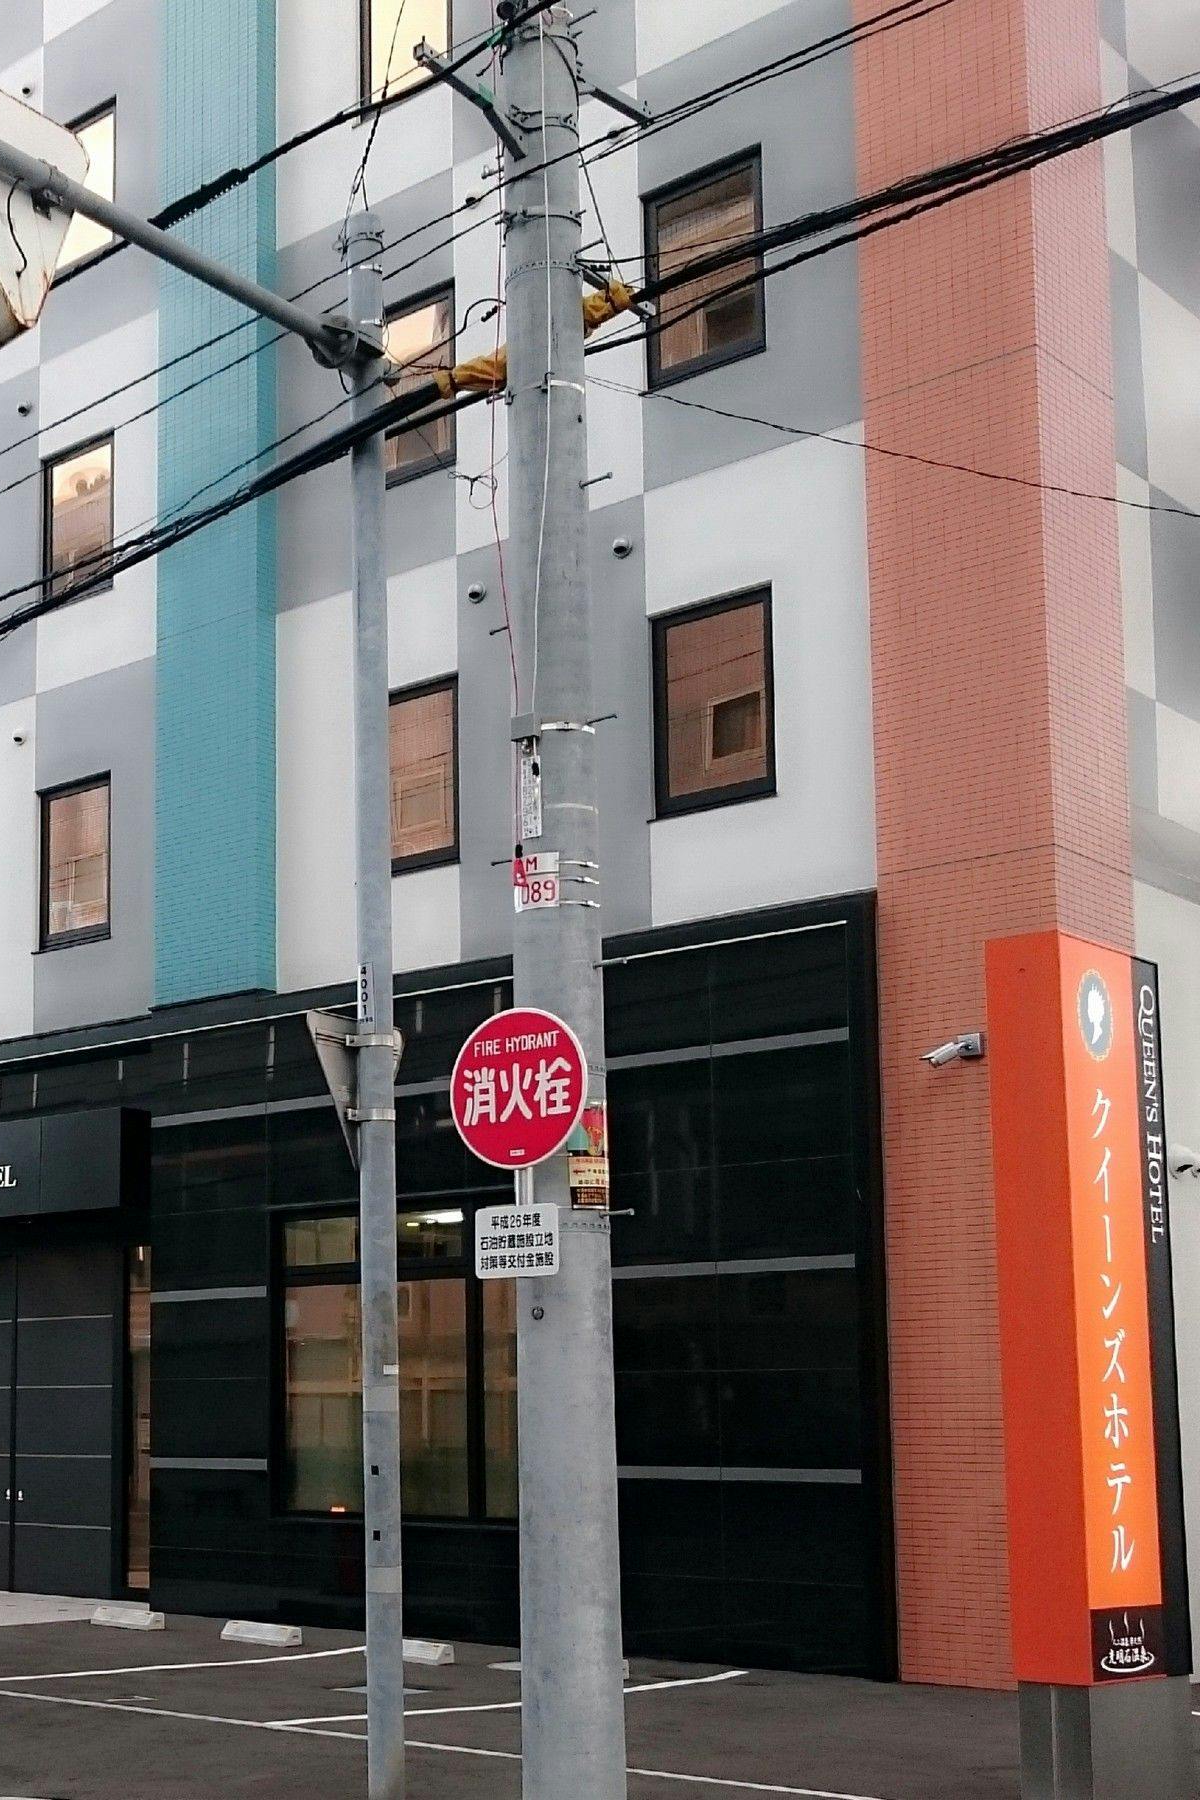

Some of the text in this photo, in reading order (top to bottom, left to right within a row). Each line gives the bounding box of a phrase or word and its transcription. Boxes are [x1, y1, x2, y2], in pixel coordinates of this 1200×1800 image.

[360, 966, 368, 1016] 4001
[474, 1030, 560, 1057] FIRE HYDRANT
[463, 1056, 572, 1127] 消火栓
[1138, 984, 1164, 1244] QUEEN'S HOTEL
[491, 1212, 542, 1230] 平成26年度
[480, 1231, 554, 1251] 石油貯蔵施設立地
[480, 1251, 555, 1271] 対策等交付金施設
[1091, 1088, 1135, 1574] クイーンズホテル
